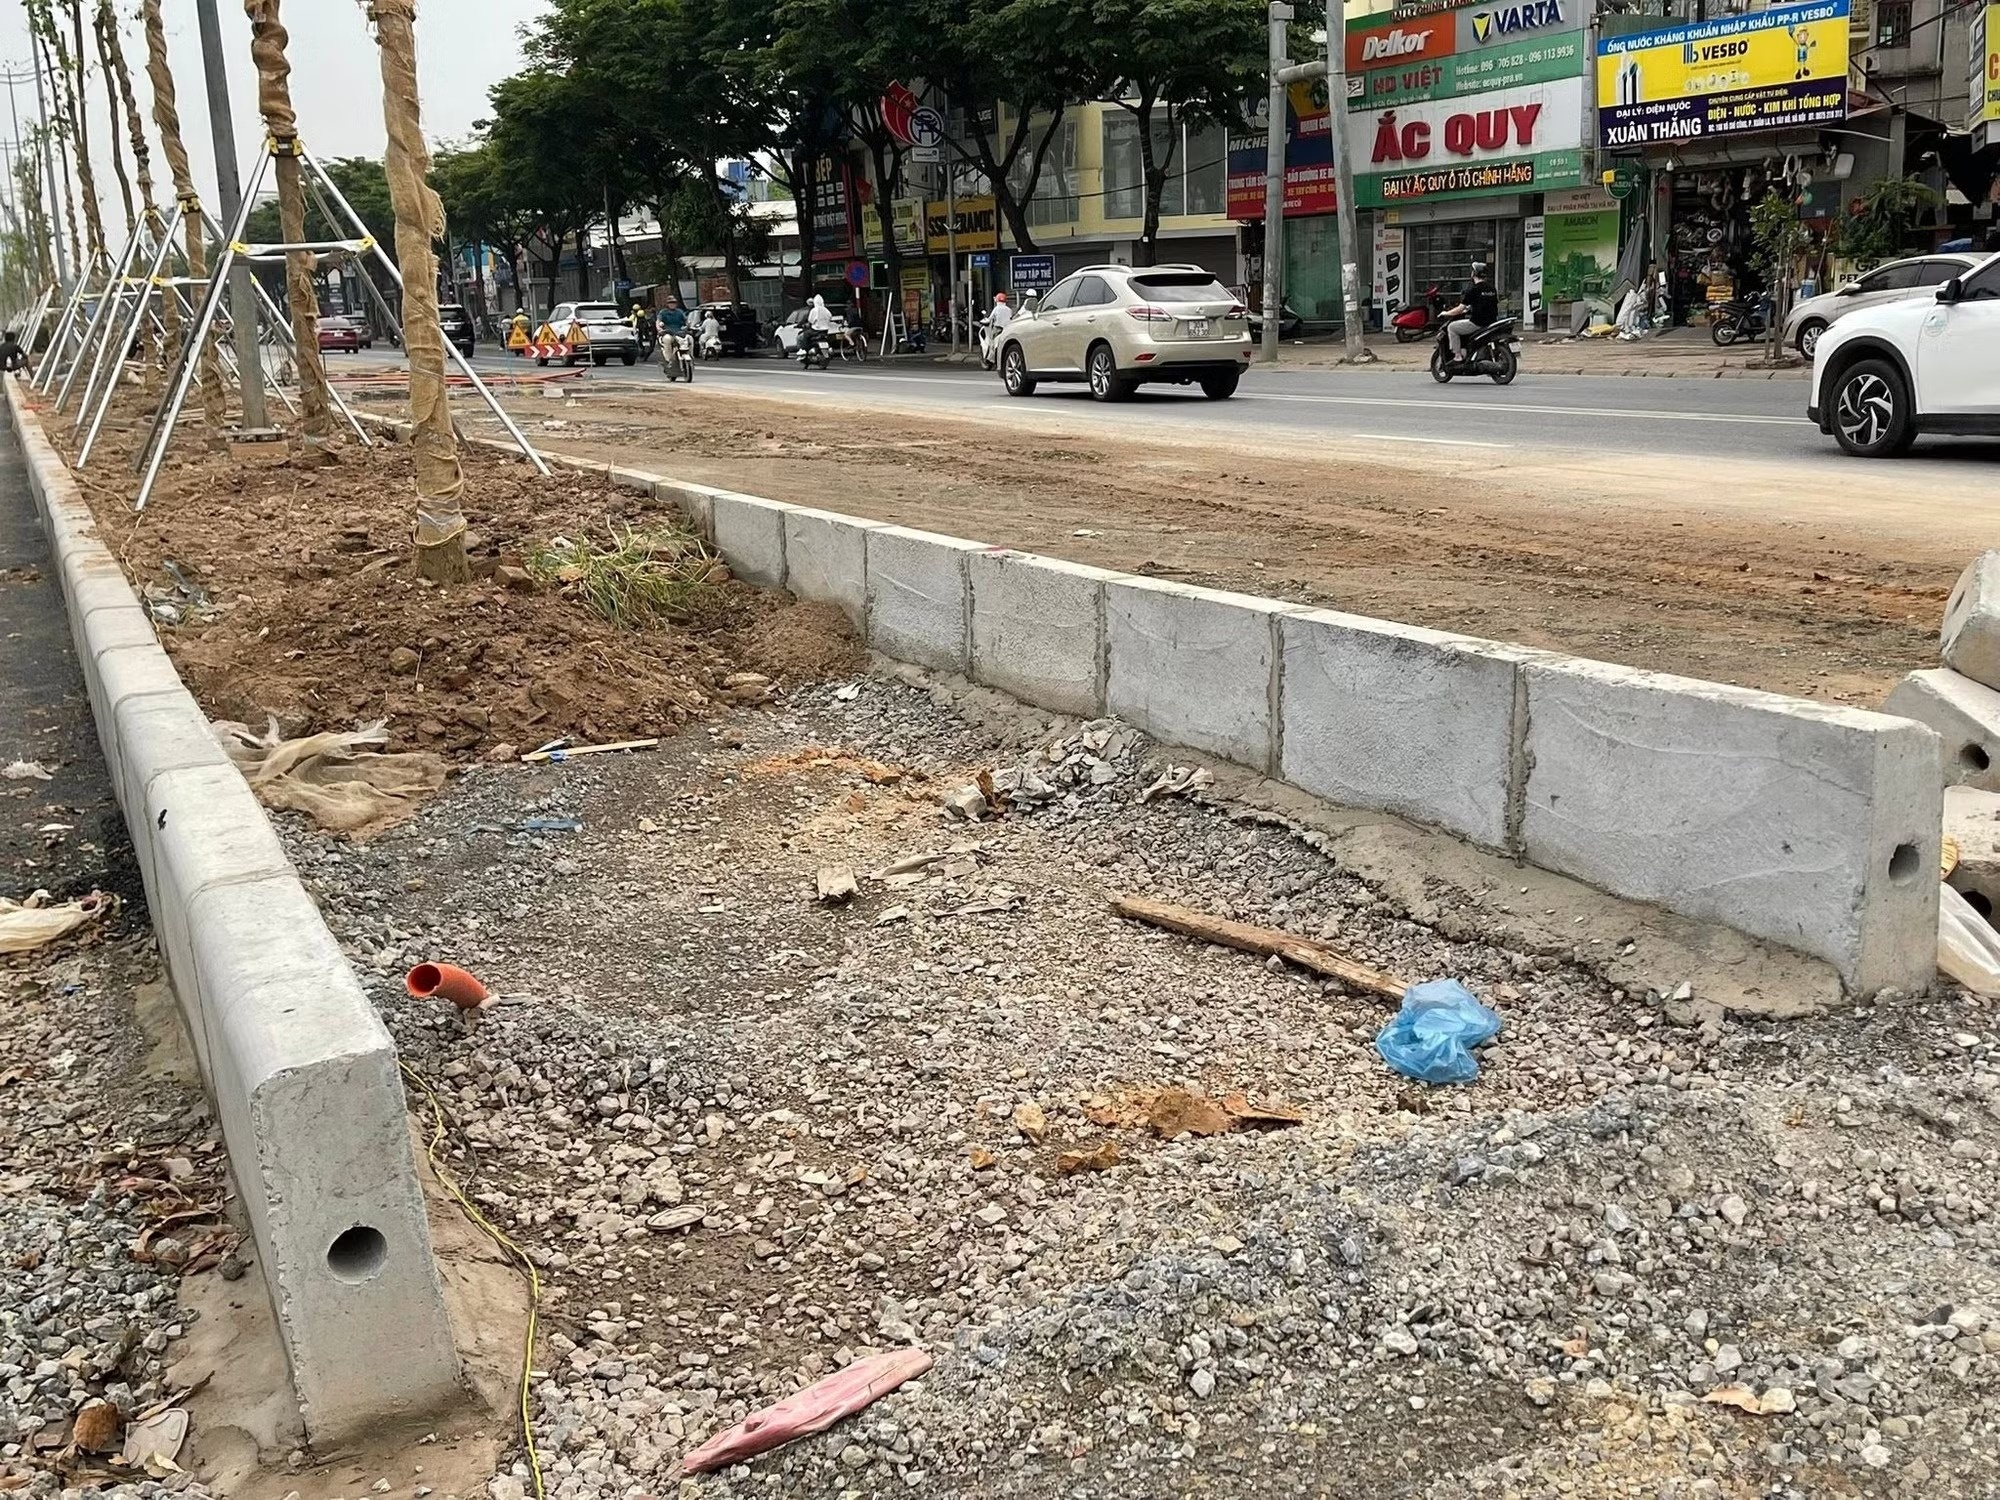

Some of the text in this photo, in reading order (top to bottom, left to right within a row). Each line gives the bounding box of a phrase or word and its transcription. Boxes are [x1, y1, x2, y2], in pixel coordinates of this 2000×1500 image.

[1496, 0, 1564, 33] VARTA
[1607, 6, 1834, 53] ỐNG NƯỚC KHÁNG KHUẨN NHẬP KHẨU PP-R VESBO
[1362, 29, 1434, 61] Delkor
[1702, 40, 1748, 61] VESBO
[1373, 64, 1442, 95] HD VIỆT
[1666, 100, 1691, 112] NƯỚC
[1708, 106, 1727, 121] ĐIỆN
[1734, 102, 1757, 117] NƯỚC
[1764, 101, 1780, 114] KIM
[1782, 96, 1797, 111] KHÍ
[1798, 93, 1821, 109] TỔNG
[1823, 93, 1841, 108] HỢP
[1371, 104, 1543, 163] ẮC QUY
[1607, 111, 1702, 145] XUÂN THẮNG
[1400, 174, 1412, 194] LÝ
[1428, 175, 1447, 191] QUY
[1472, 164, 1502, 187] CHÍNH
